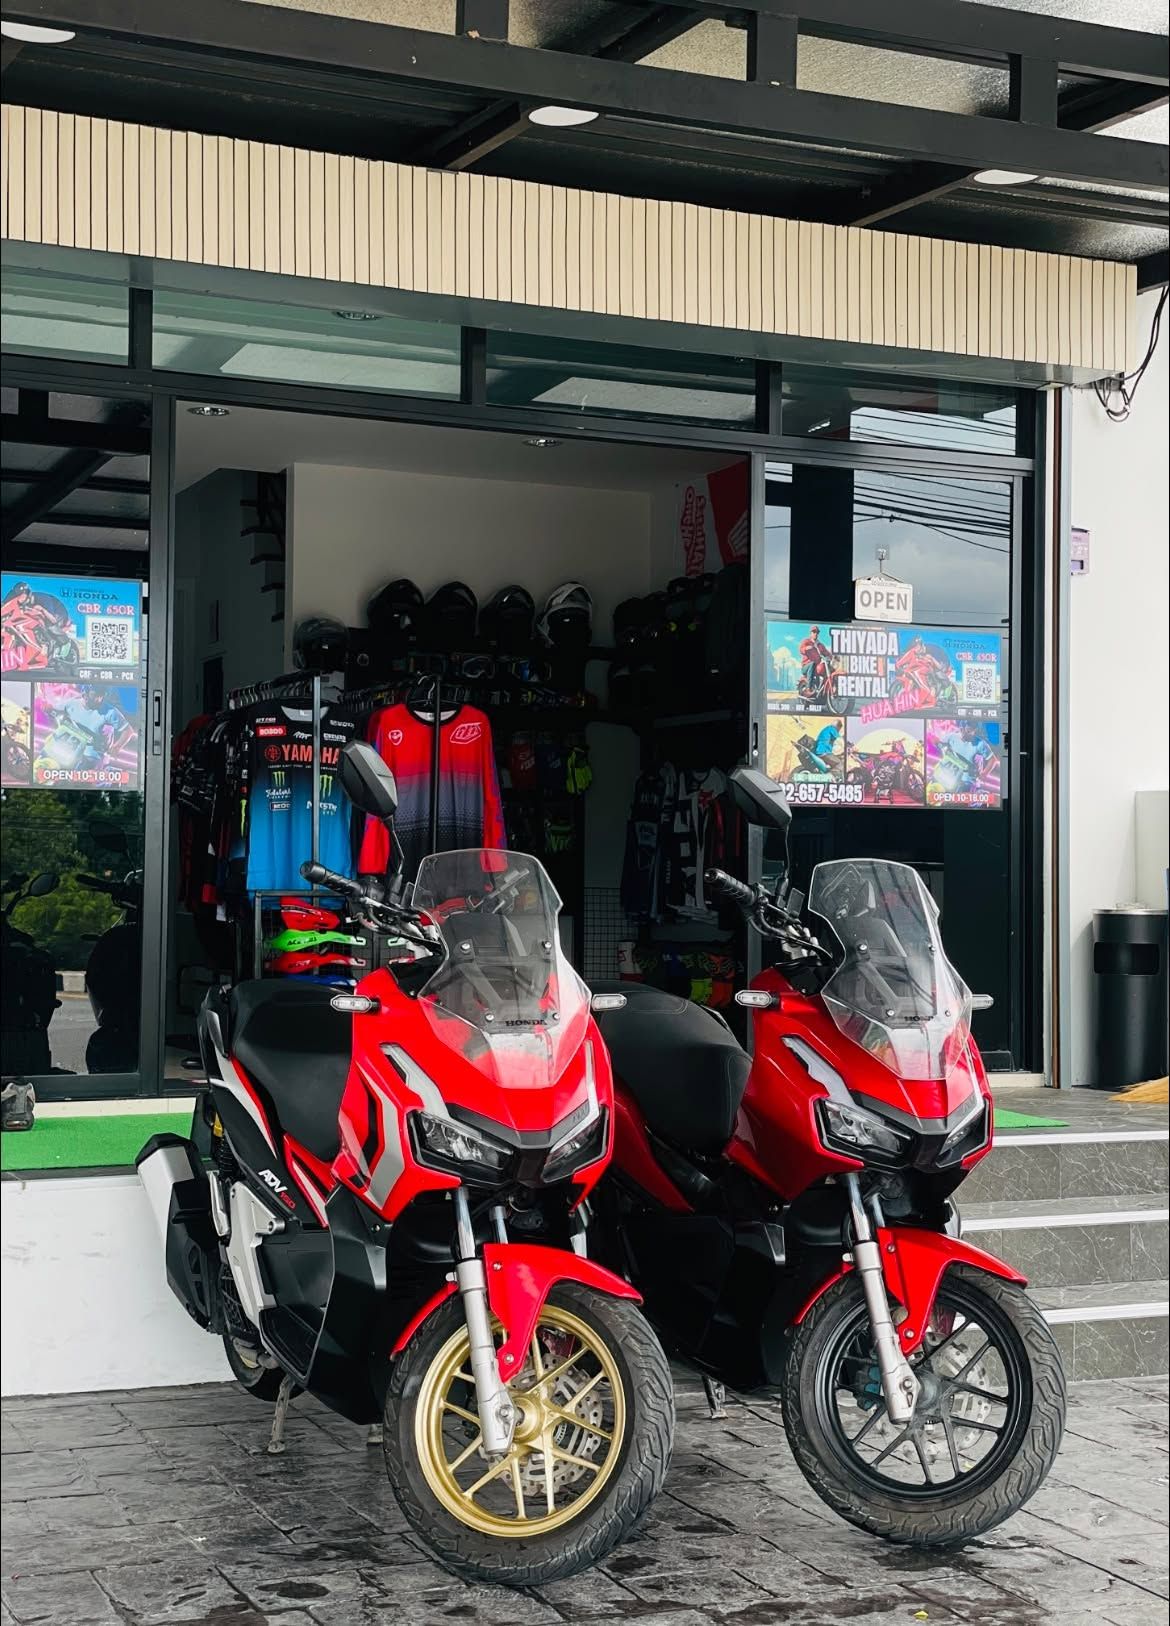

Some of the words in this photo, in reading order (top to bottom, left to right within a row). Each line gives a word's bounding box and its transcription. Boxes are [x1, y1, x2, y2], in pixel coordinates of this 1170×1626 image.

[73, 592, 118, 600] HONDA
[860, 590, 908, 611] OPEN
[77, 603, 101, 614] CBR
[106, 605, 135, 616] 650R
[830, 629, 899, 656] THIYADA
[850, 655, 878, 674] BIKE
[837, 675, 889, 697] RENTAL
[861, 698, 893, 723] HUA
[893, 687, 920, 713] HIN
[281, 744, 340, 764] YAMHA
[43, 771, 73, 780] OPEN
[933, 792, 955, 802] OPEN
[505, 1019, 547, 1027] HONDA
[258, 1169, 288, 1193] ADV
